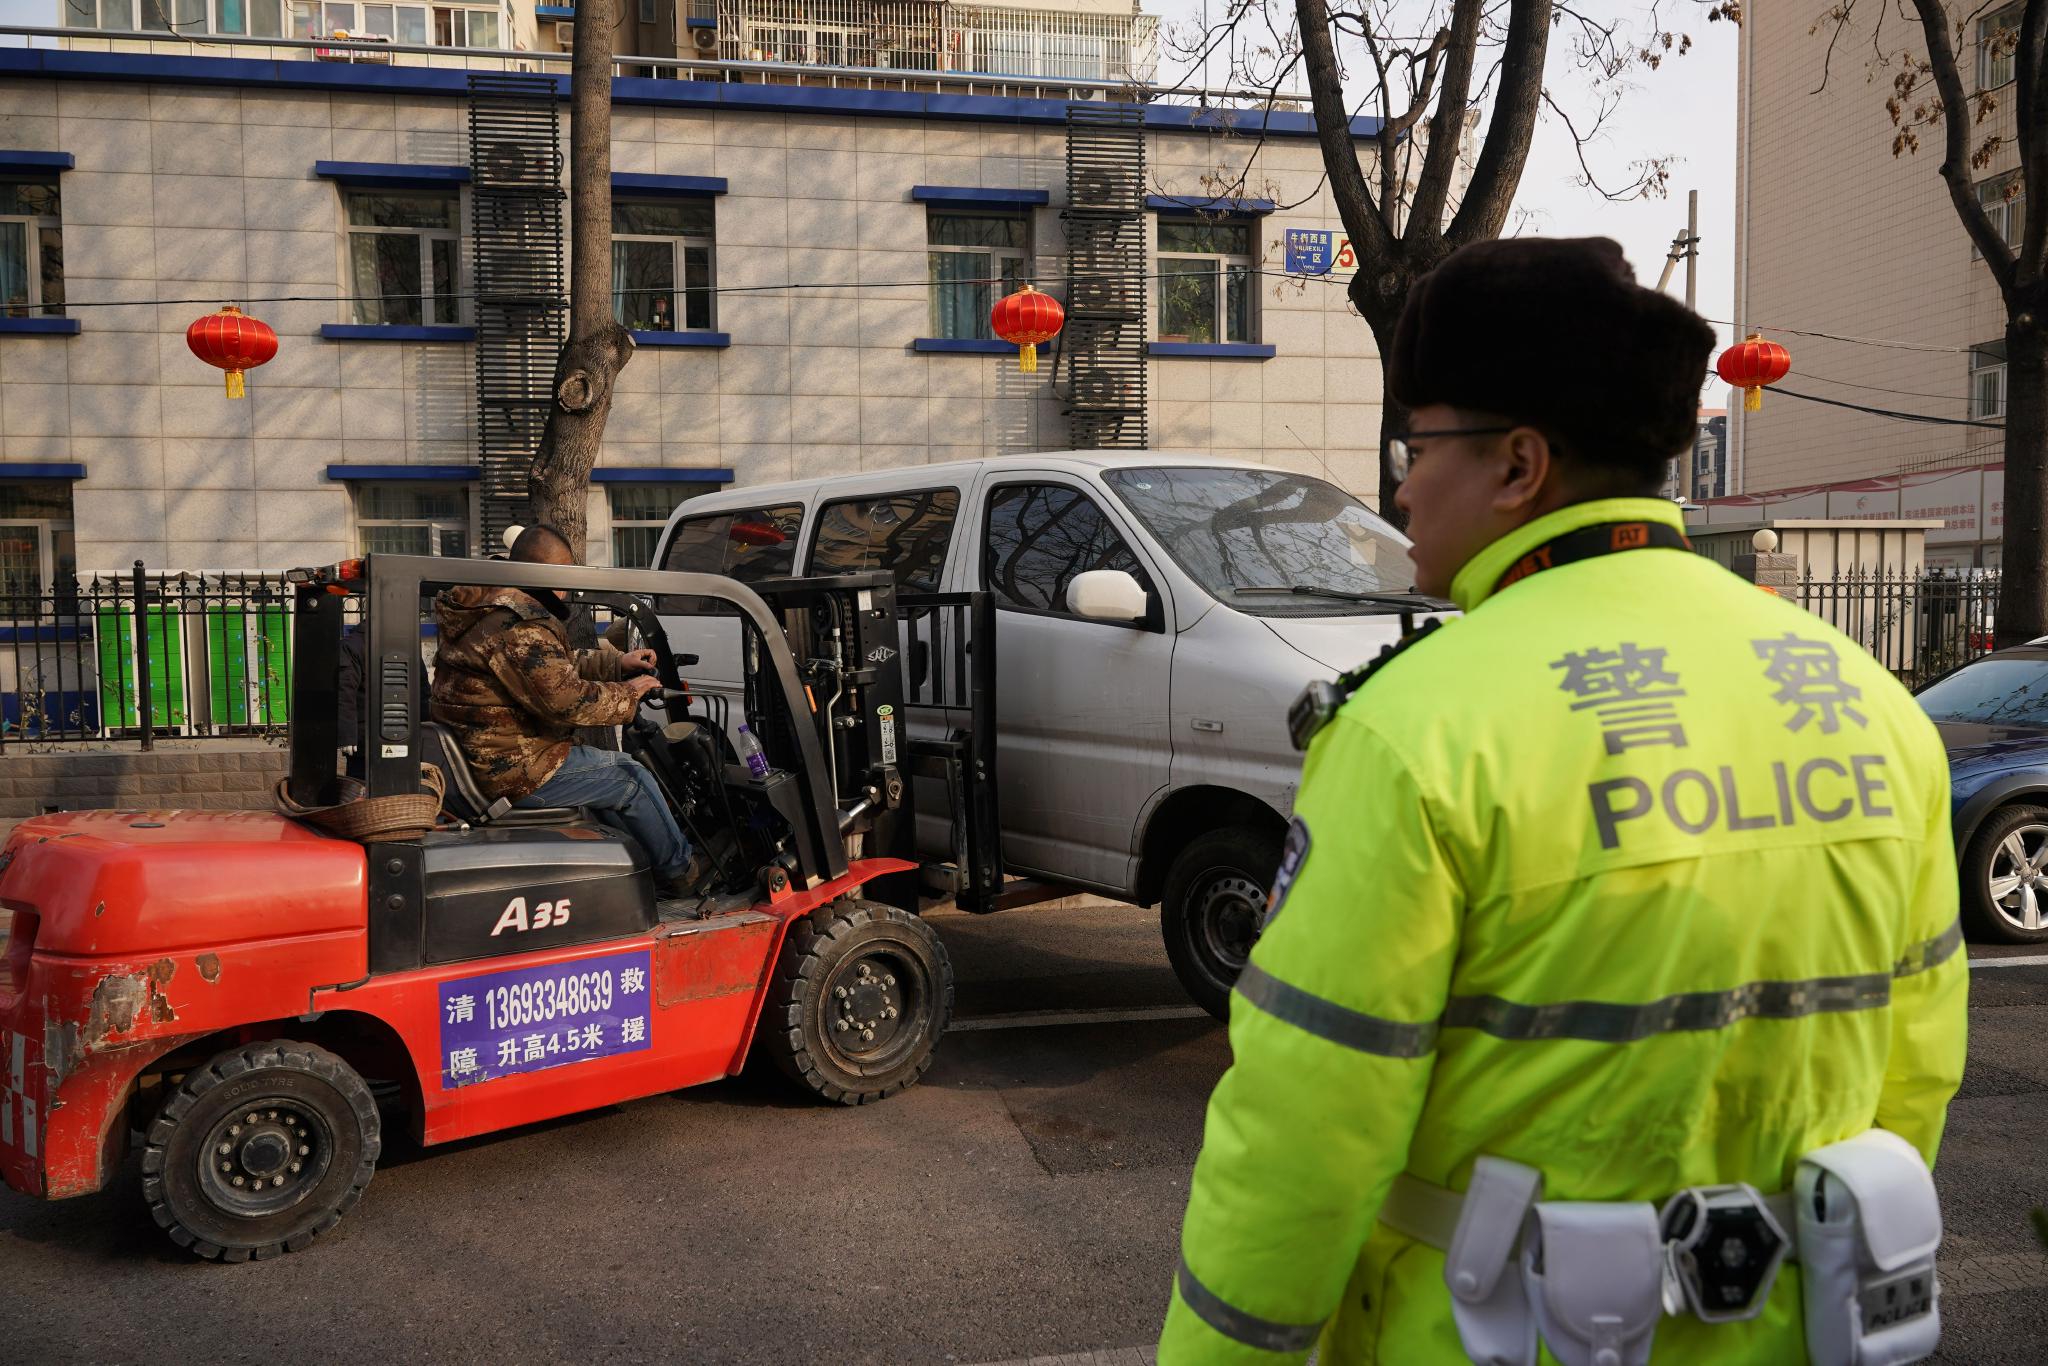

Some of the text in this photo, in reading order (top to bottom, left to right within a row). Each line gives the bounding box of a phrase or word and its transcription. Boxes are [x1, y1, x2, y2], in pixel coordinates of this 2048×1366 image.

[1291, 232, 1327, 245] 牛街西里
[1338, 239, 1354, 267] 5
[1549, 633, 1868, 755] 警察
[1588, 755, 1893, 849] POLICE
[490, 896, 572, 937] A35
[485, 970, 612, 1030] 13693348639
[498, 1023, 604, 1067] 升高4.5米
